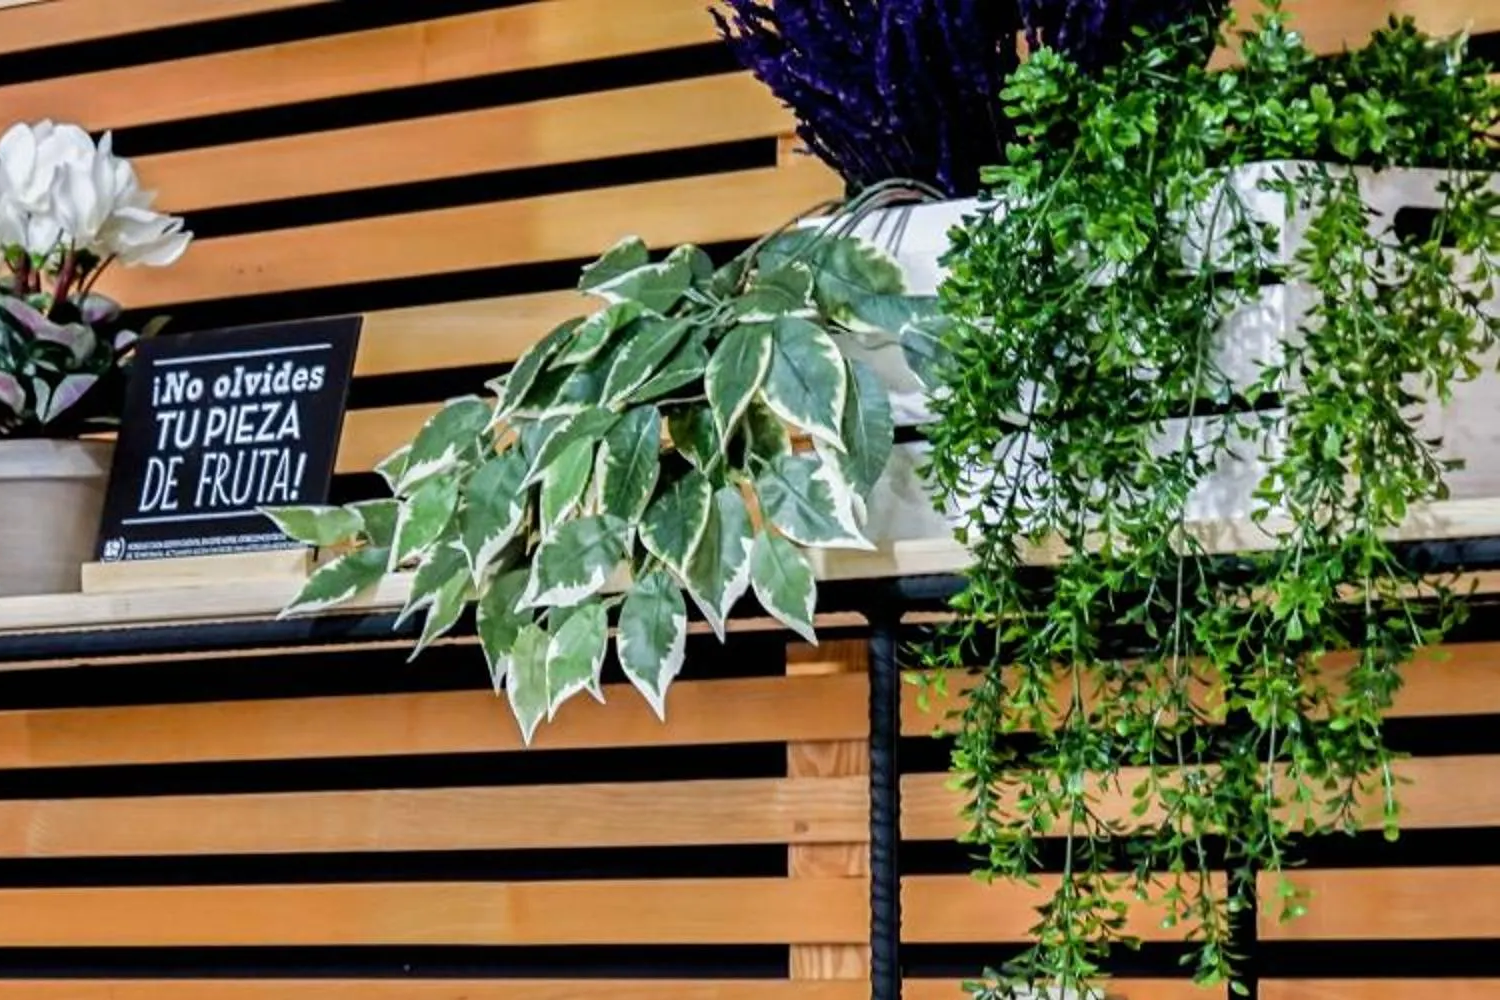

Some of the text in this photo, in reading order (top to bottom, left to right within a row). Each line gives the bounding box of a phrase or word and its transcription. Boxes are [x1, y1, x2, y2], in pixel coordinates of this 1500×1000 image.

[151, 360, 326, 407] ¡No olvides
[155, 400, 301, 450] TU PIEZA
[137, 447, 308, 512] DE FRUTA!
